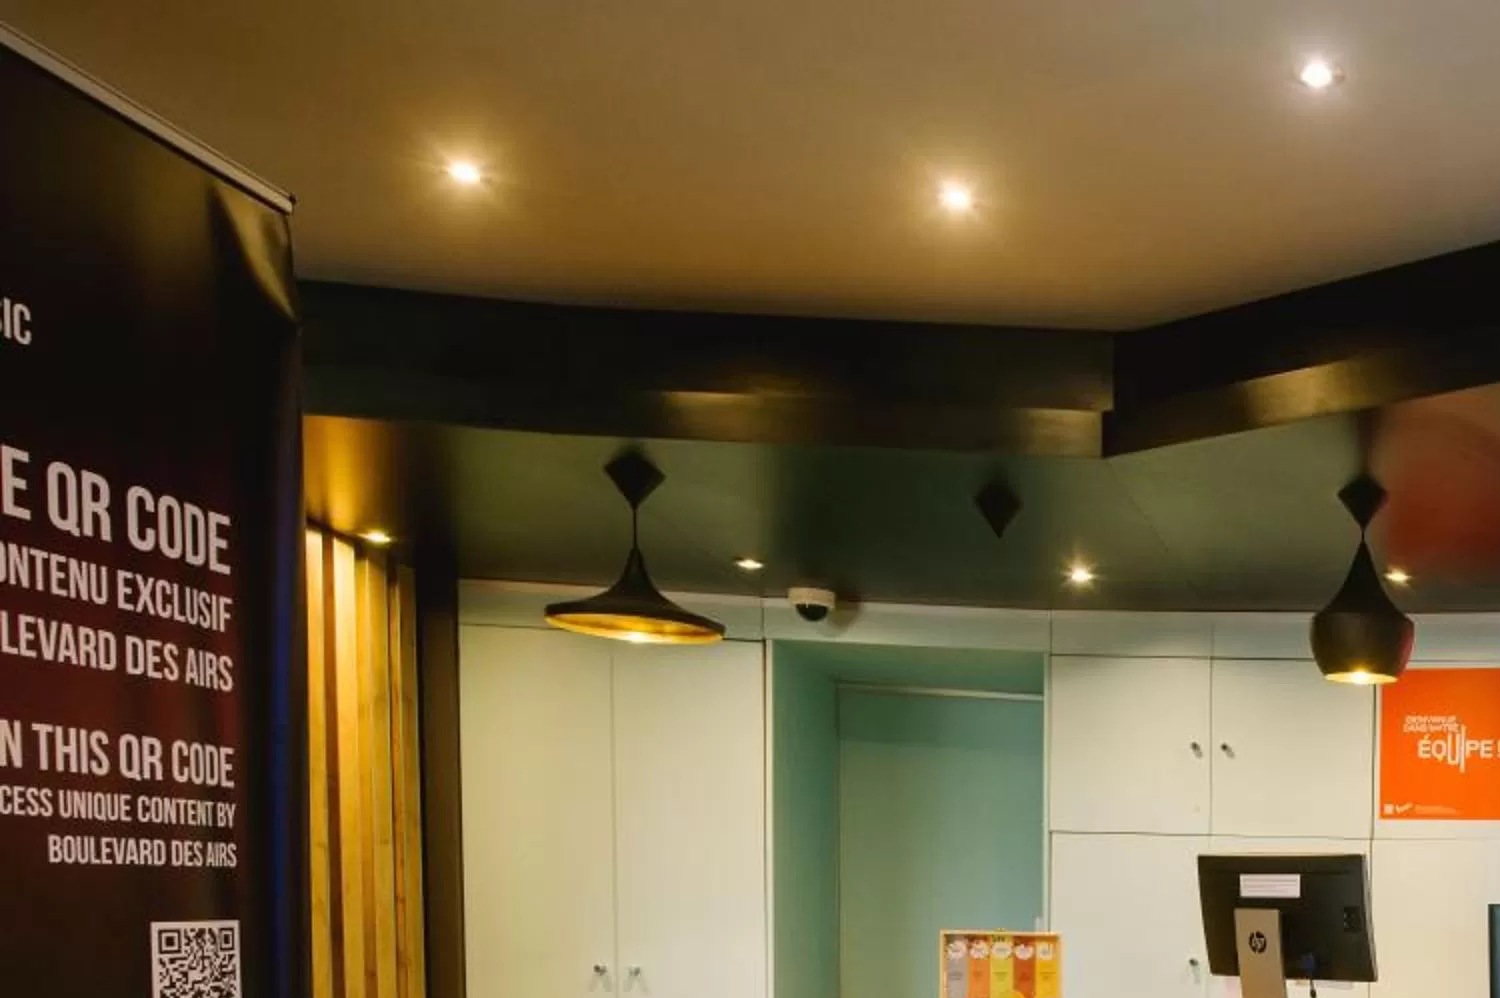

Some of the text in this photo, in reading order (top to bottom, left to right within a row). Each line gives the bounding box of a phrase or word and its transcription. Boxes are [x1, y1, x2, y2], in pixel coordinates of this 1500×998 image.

[0, 298, 32, 345] IC
[46, 460, 113, 543] QR
[126, 485, 232, 575] CODE
[117, 569, 233, 633] EXCLUSIF
[125, 635, 179, 681] DES
[185, 647, 234, 692] AIRS
[31, 723, 110, 776] THIS
[119, 733, 163, 781] QR
[171, 740, 236, 788] CODE
[58, 789, 132, 822] UNIQUE
[137, 795, 214, 827] CONTENT
[216, 802, 236, 829] BY
[48, 834, 238, 869] BOULEVARD DES AIRS
